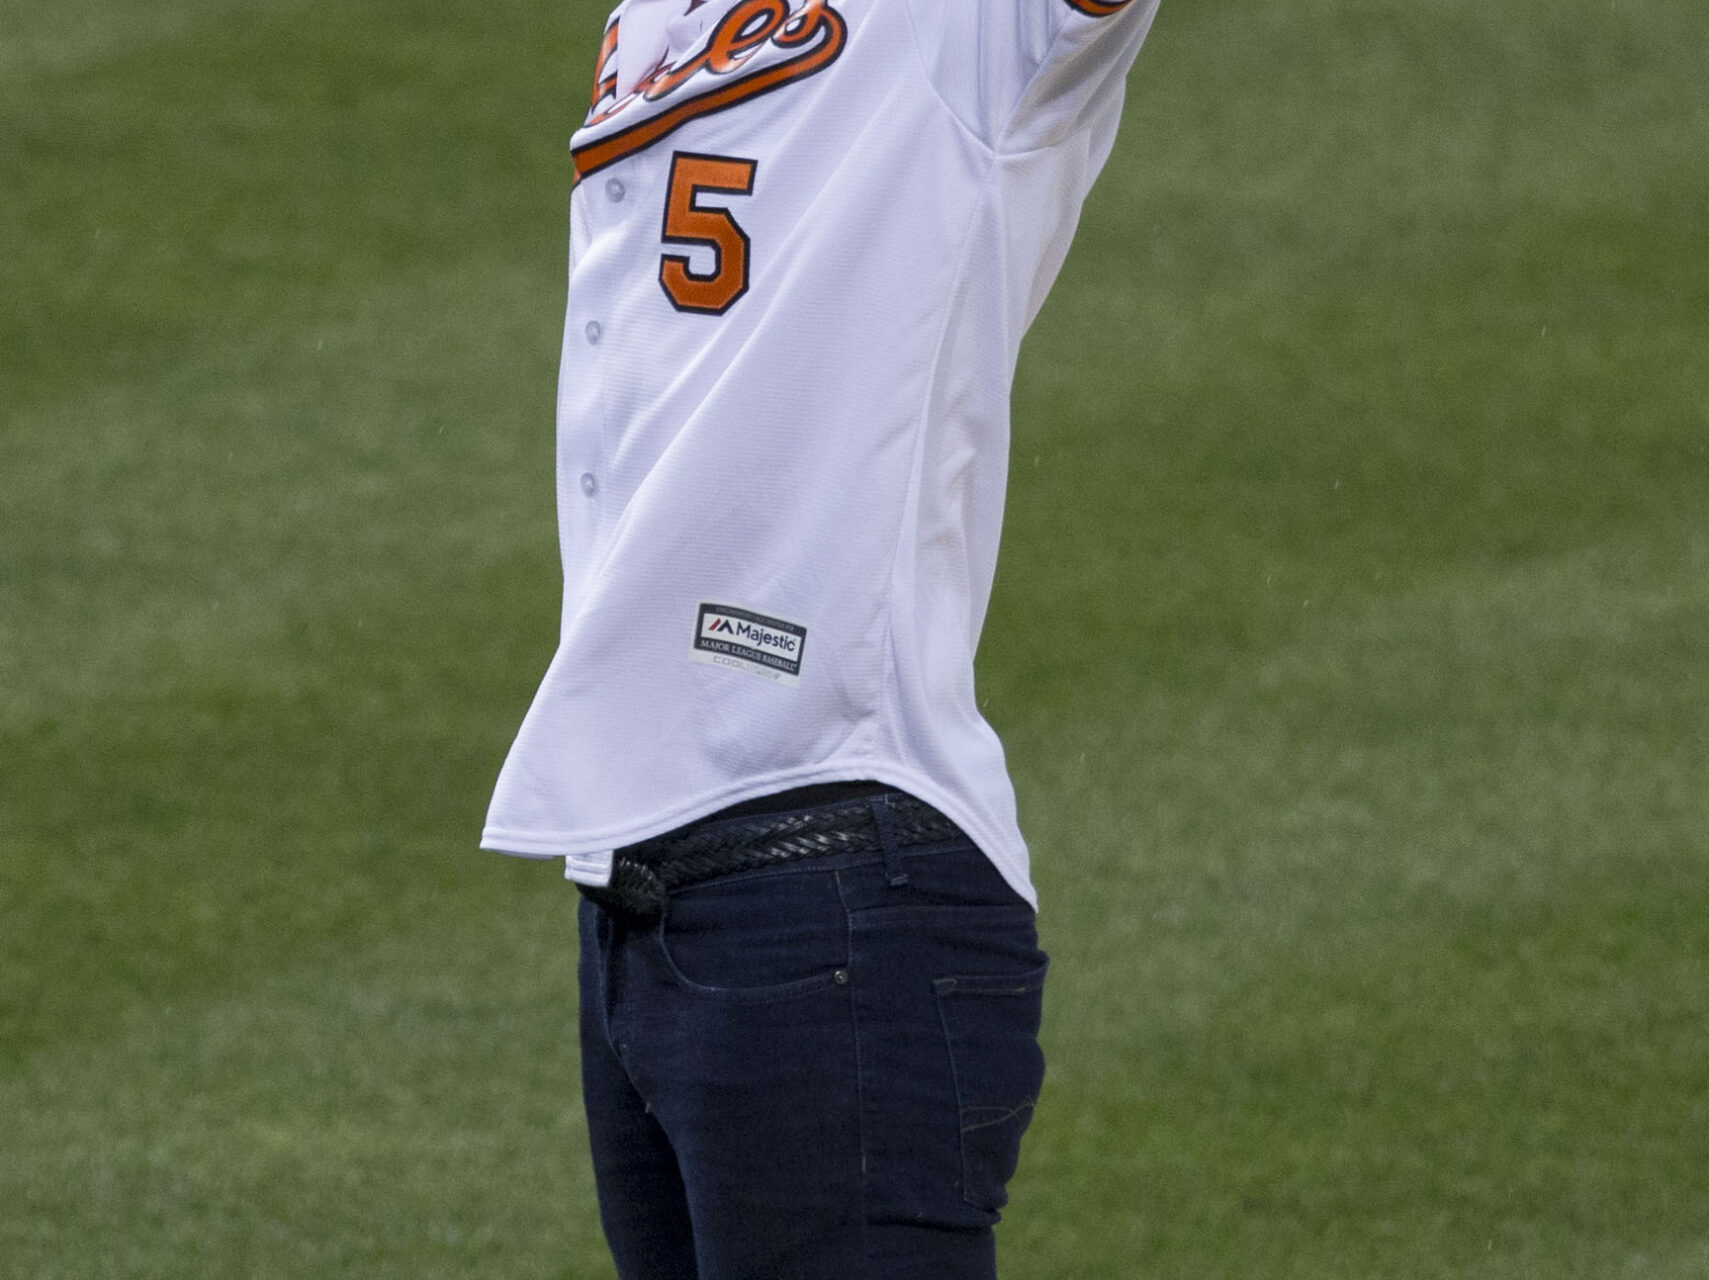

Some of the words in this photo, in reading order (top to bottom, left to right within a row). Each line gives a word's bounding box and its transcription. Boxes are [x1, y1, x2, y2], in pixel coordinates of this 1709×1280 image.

[658, 150, 758, 316] 5
[700, 639, 730, 652] MAJOR
[731, 643, 761, 661] LEAGUE
[736, 621, 796, 652] Majestic
